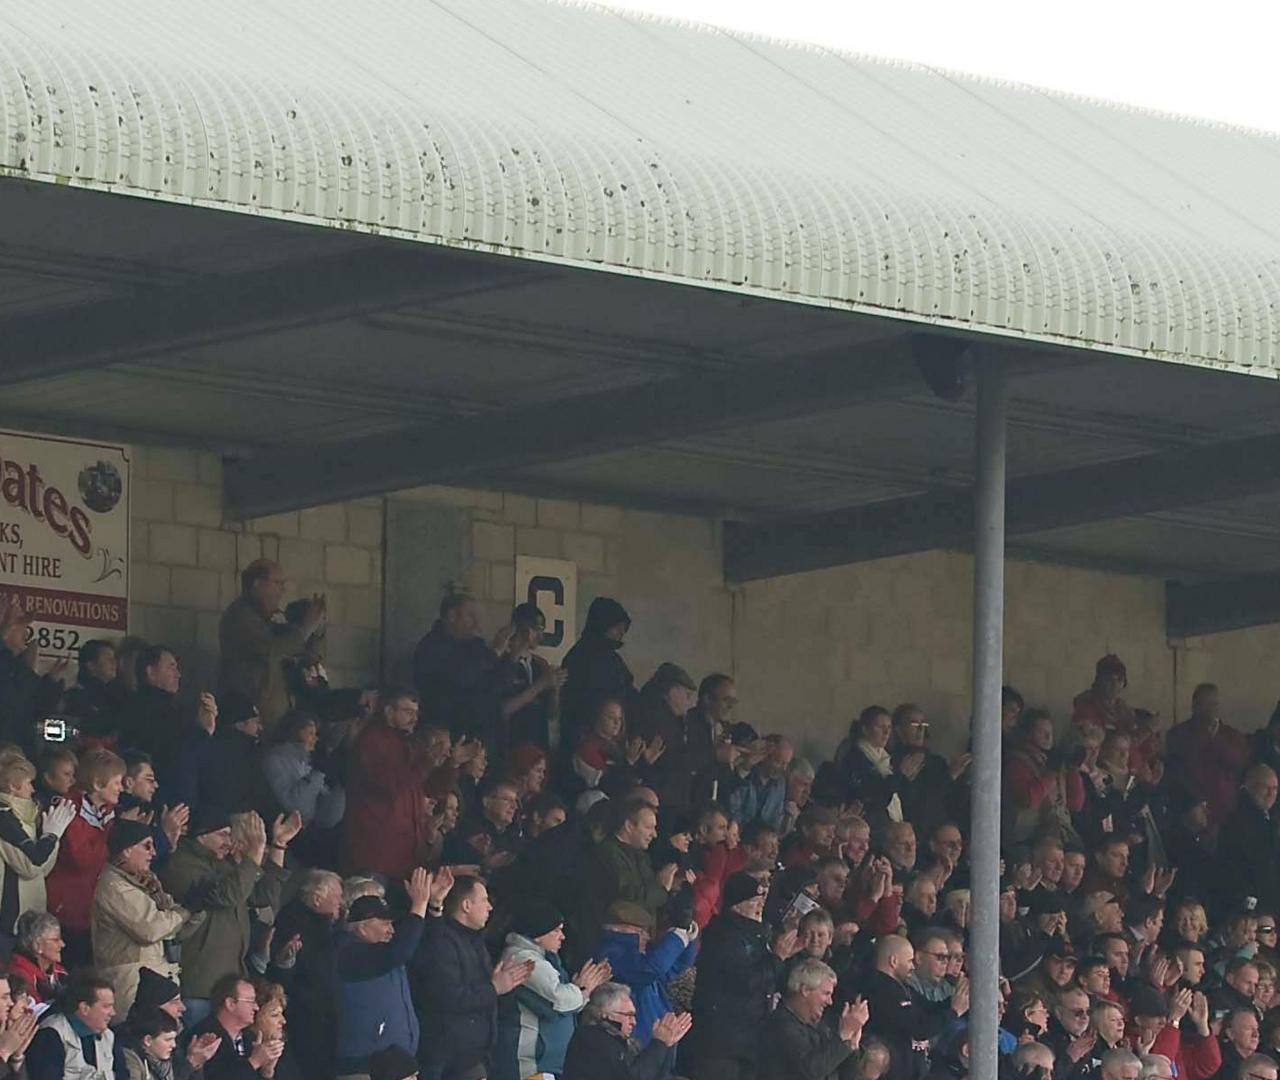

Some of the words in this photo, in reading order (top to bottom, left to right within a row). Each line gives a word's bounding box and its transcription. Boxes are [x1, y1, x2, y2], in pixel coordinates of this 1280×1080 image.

[23, 555, 63, 579] HIRE
[25, 592, 119, 622] RENOVATIONS
[527, 576, 564, 647] C
